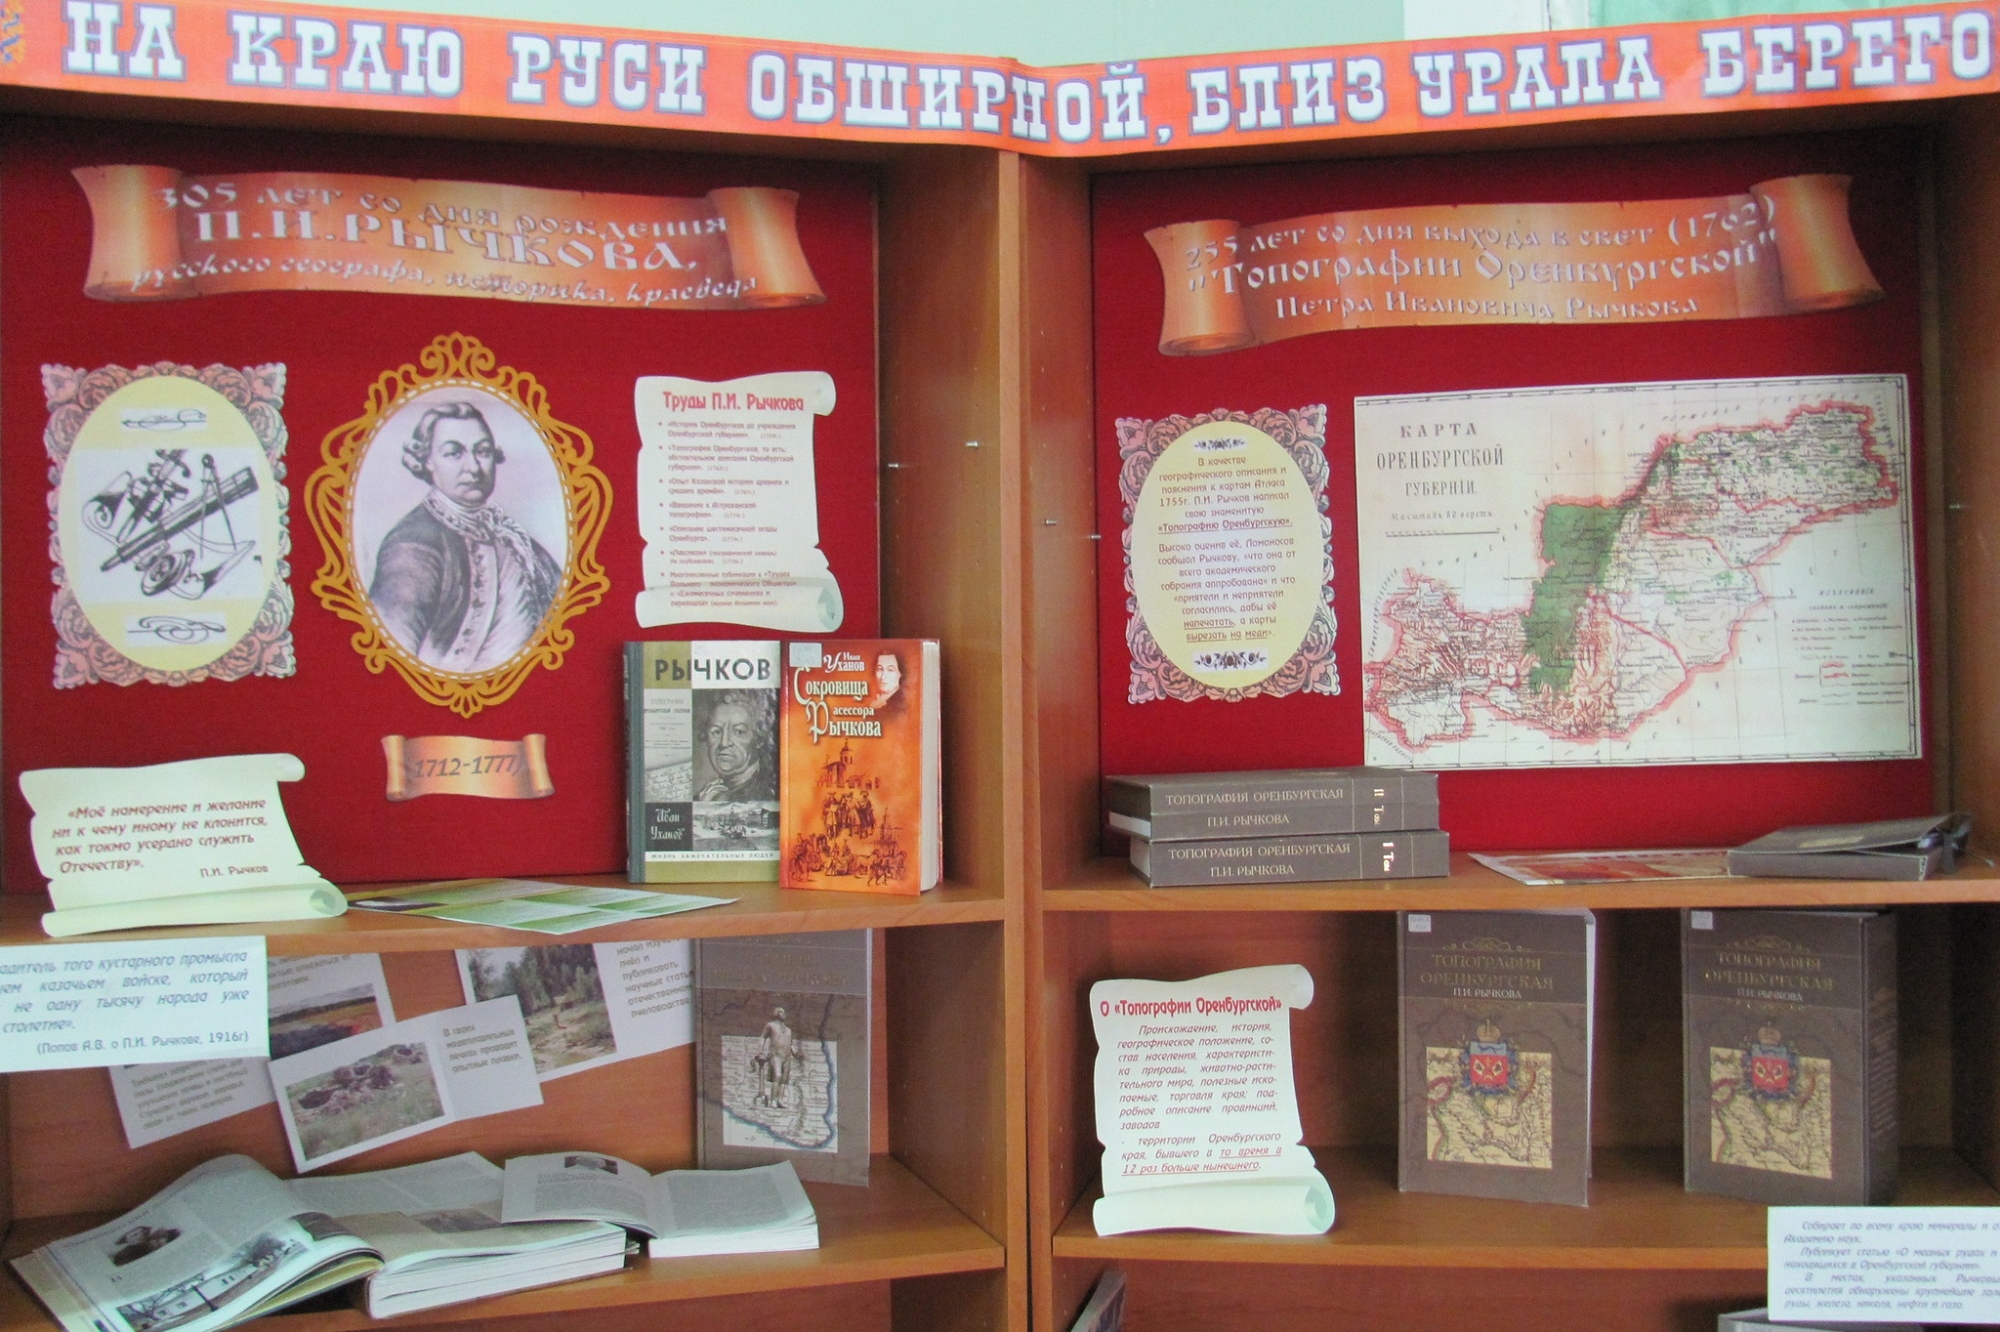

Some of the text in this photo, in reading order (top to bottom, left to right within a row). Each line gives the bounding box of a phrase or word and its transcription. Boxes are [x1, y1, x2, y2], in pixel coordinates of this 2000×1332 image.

[62, 0, 186, 81] НА
[227, 11, 464, 97] КРАЮ
[507, 32, 707, 116] РУСИ
[747, 50, 1174, 145] ОБШИРНОЙ,
[1187, 56, 1386, 136] БЛИЗ
[1412, 35, 1663, 118] УРАЛА
[1186, 236, 1238, 271] 255
[1357, 224, 1413, 245] дня
[663, 391, 804, 412] Труды П.И. Рычкова
[1400, 423, 1478, 438] КАРТА
[1208, 456, 1246, 466] качестве
[1377, 443, 1504, 470] ОРЕНБУРГСКОЙ
[1159, 468, 1277, 482] географического описания
[1162, 480, 1285, 494] пояснения картам Атласа
[1217, 492, 1289, 504] Рычков написал
[1185, 507, 1264, 518] свою знаменитую
[1158, 521, 1219, 534] «Топографию
[1159, 538, 1294, 553] Высоко оценив Ломоносов
[1179, 564, 1276, 577] всего академического
[1161, 581, 1201, 591] собрания
[1174, 590, 1283, 604] «приятели неприятели
[1249, 616, 1276, 625] карты
[823, 652, 865, 673] Уханов
[843, 652, 861, 660] Иван
[655, 658, 771, 681] РЫЧКОВ
[794, 667, 868, 705] Сокровища
[833, 706, 875, 720] асессора
[806, 700, 881, 744] Рычкова
[1166, 789, 1343, 806] ТОПОГРАФИЯ ОРЕНБУРГСКАЯ
[68, 799, 266, 819] «Моё намерение желание
[656, 808, 680, 823] Иван
[1207, 813, 1289, 827] П.И. РЫЧКОВА
[92, 823, 126, 836] чему
[182, 819, 198, 830] не
[651, 826, 685, 841] Уханов
[56, 834, 254, 856] как токмо усердно служить
[1168, 843, 1350, 860] ТОПОГРАФИЯ ОРЕНБУРГСКАЯ
[229, 864, 268, 875] Рычков
[1211, 865, 1294, 878] П.И. РЫЧКОВА
[64, 952, 247, 971] того кустарного промысла
[1432, 954, 1542, 970] ТОПОГРАФИЯ
[40, 969, 248, 991] казачьем который
[1421, 972, 1553, 989] ОРЕНБУРГСКАЯ
[47, 990, 249, 1012] одну тысячу народа уже
[1475, 989, 1521, 999] РЫЧКОВА
[1100, 996, 1281, 1018] О «Топографии Оренбургской»
[1139, 1023, 1272, 1036] Происхождение, история,
[37, 1031, 249, 1055] (Попов П.И. 1916г)
[1117, 1036, 1254, 1050] географическое положение,
[1118, 1049, 1275, 1062] став населения, характеристи-
[1118, 1067, 1130, 1076] ка
[1200, 1063, 1275, 1073] животно-расти-
[1120, 1075, 1276, 1089] тельного мира, полезные иско-
[1170, 1091, 1213, 1102] торговля
[1256, 1090, 1277, 1098] под-
[1119, 1105, 1211, 1118] робное описание
[1121, 1121, 1160, 1130] заводов
[1138, 1132, 1281, 1147] территории Оренбургского
[1156, 1147, 1270, 1159] бывшего время
[1123, 1161, 1261, 1175] 12 раз больше нынешнего.
